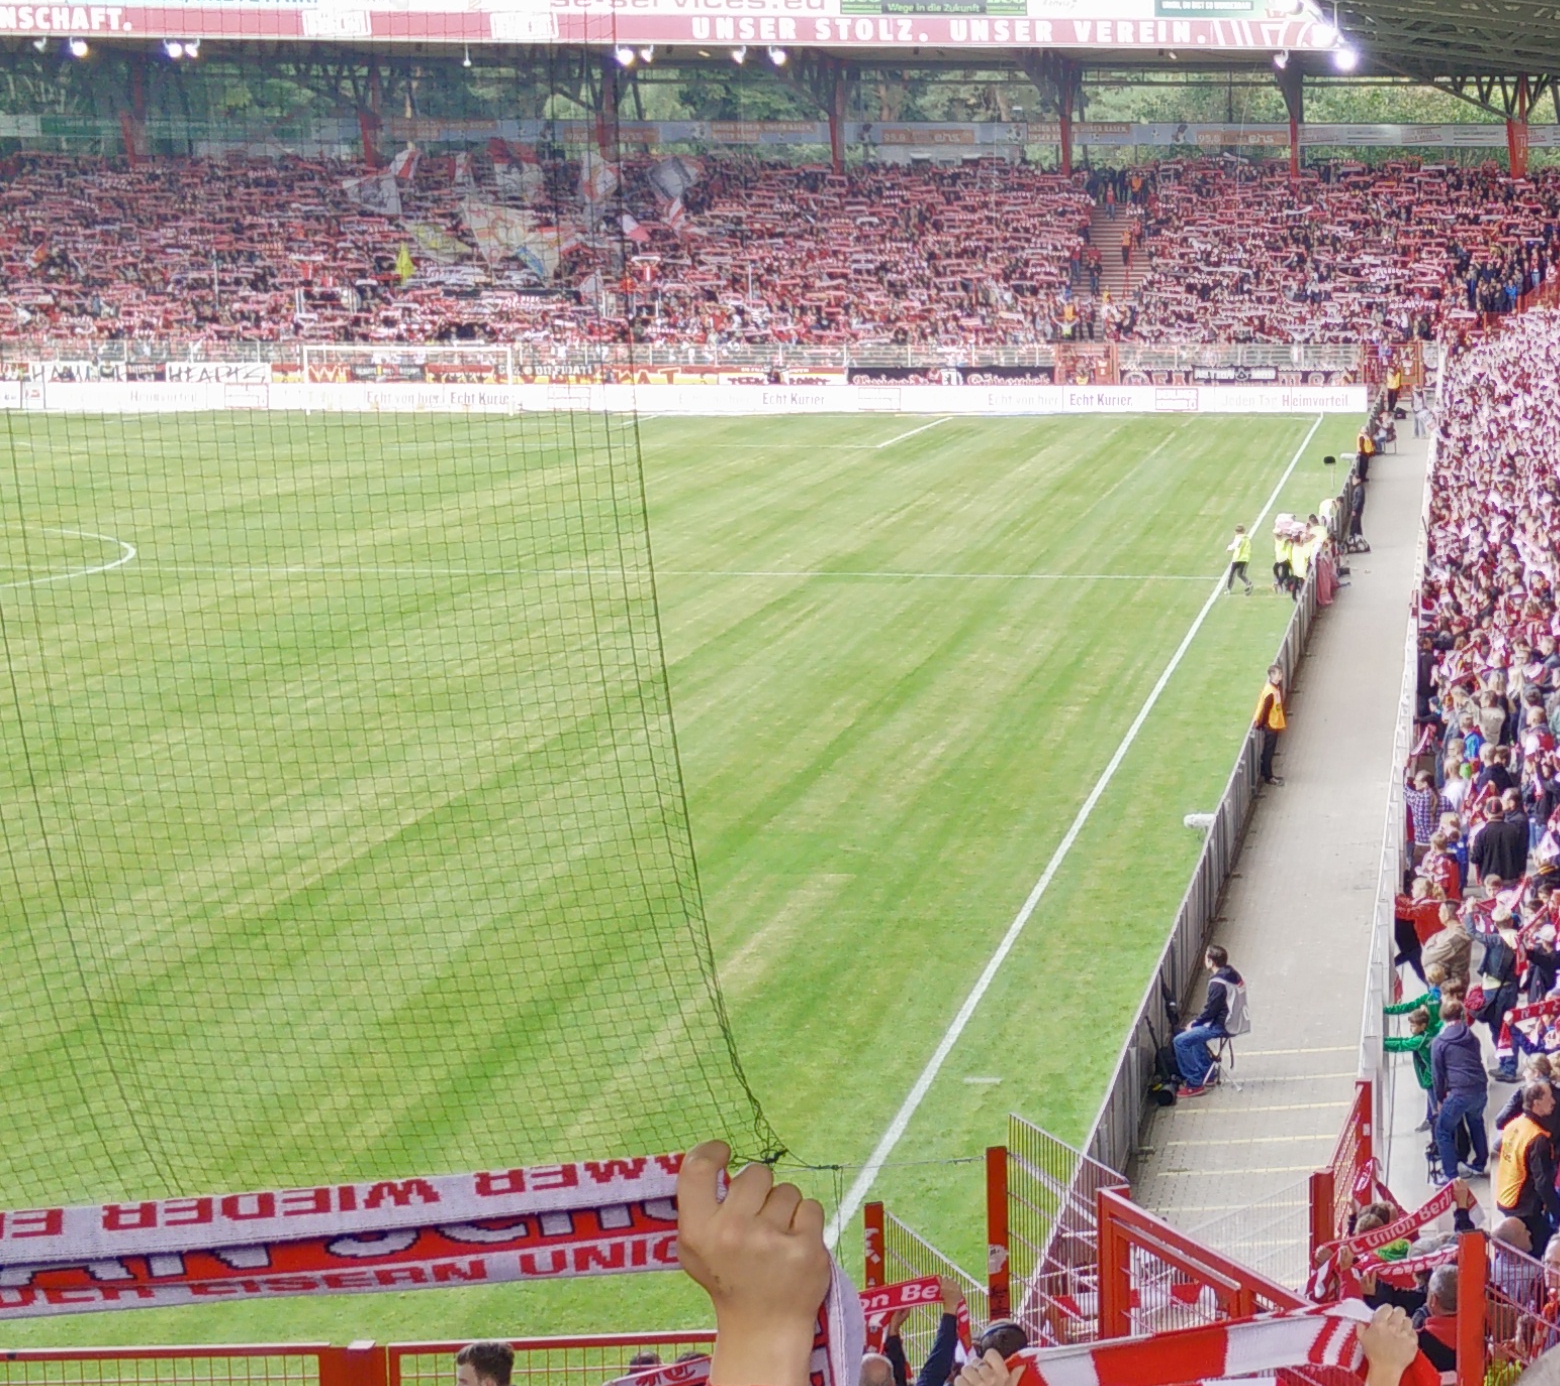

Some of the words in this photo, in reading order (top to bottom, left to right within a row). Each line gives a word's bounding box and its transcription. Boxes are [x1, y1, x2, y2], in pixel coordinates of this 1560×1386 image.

[887, 3, 914, 14] Wege
[916, 2, 926, 13] in
[928, 2, 942, 13] die
[943, 2, 980, 13] Zukunft
[692, 17, 797, 41] UNSER
[815, 18, 929, 42] STOLZ.
[950, 19, 1053, 43] UNSER
[1073, 20, 1207, 44] VEREIN.
[1069, 393, 1095, 407] Echt
[102, 1178, 442, 1232] WIEDER
[0, 1207, 64, 1241] E
[1366, 1215, 1418, 1251] Union
